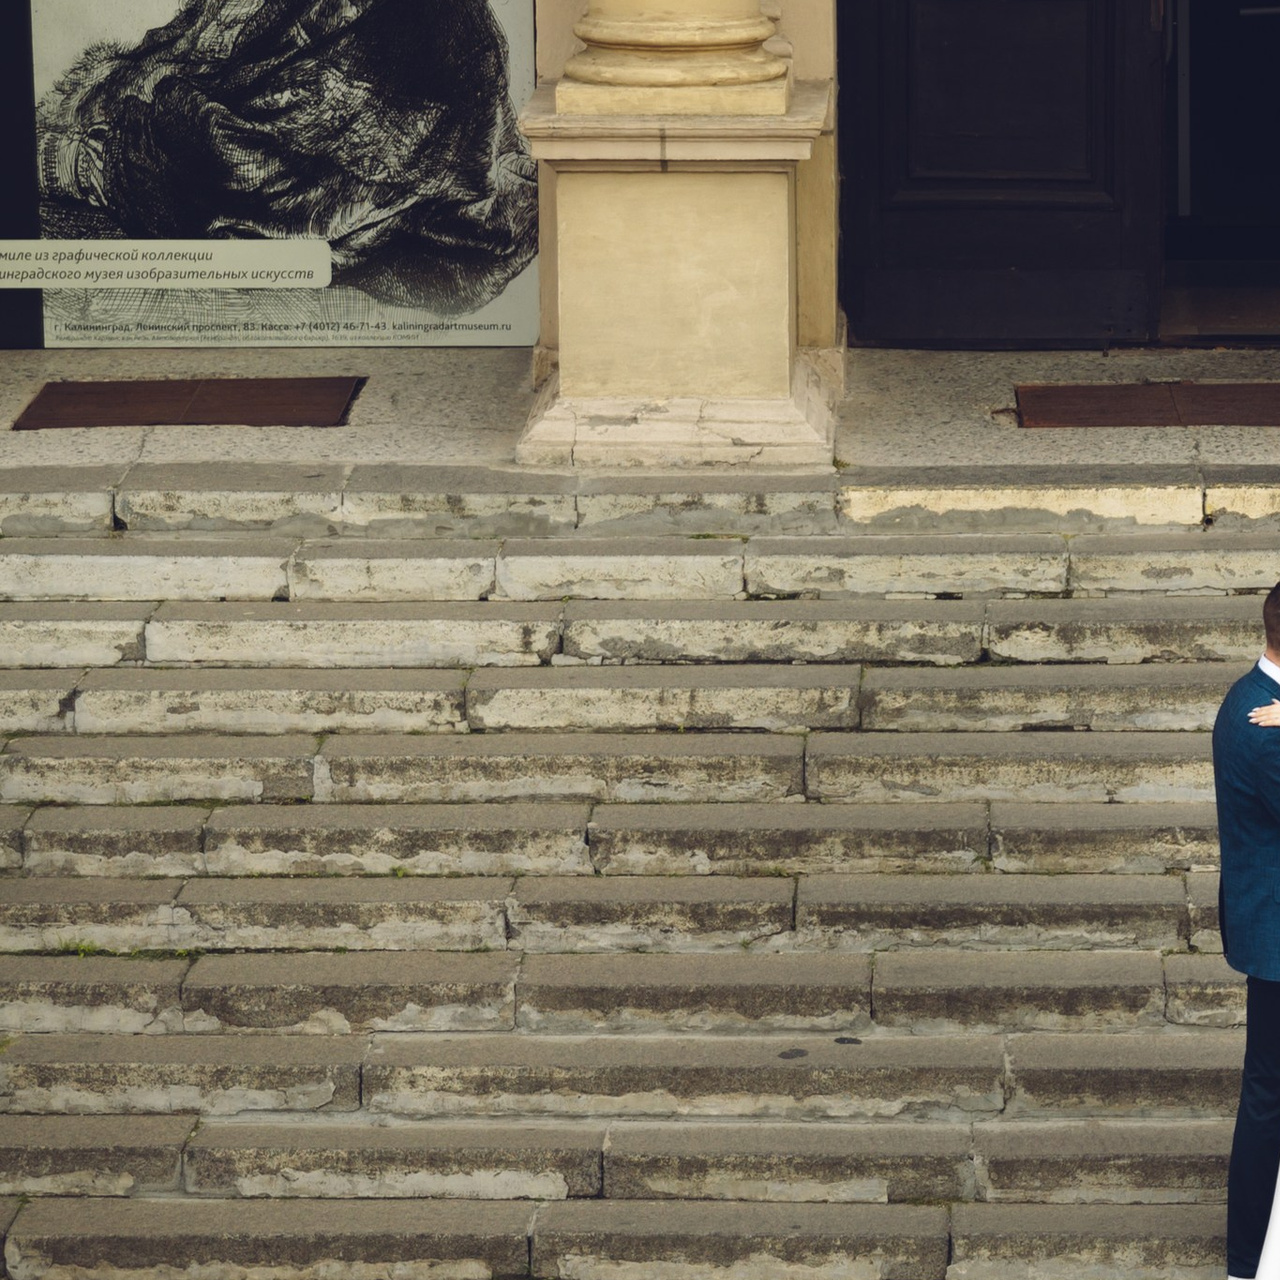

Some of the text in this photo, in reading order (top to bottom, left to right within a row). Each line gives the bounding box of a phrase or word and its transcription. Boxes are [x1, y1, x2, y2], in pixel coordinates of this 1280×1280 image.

[35, 251, 49, 261] из
[52, 248, 139, 265] графической
[141, 252, 213, 263] коллекции
[84, 270, 123, 283] музея
[126, 267, 248, 283] изобразительных
[251, 270, 314, 283] искусств
[64, 323, 133, 334] Калининград,
[135, 322, 190, 331] Ленинский
[192, 323, 241, 333] проспект,
[261, 323, 293, 331] Касса:
[294, 322, 306, 331] +7
[309, 322, 340, 333] (4012)
[392, 322, 512, 333] kaliningradartmuseum.ru
